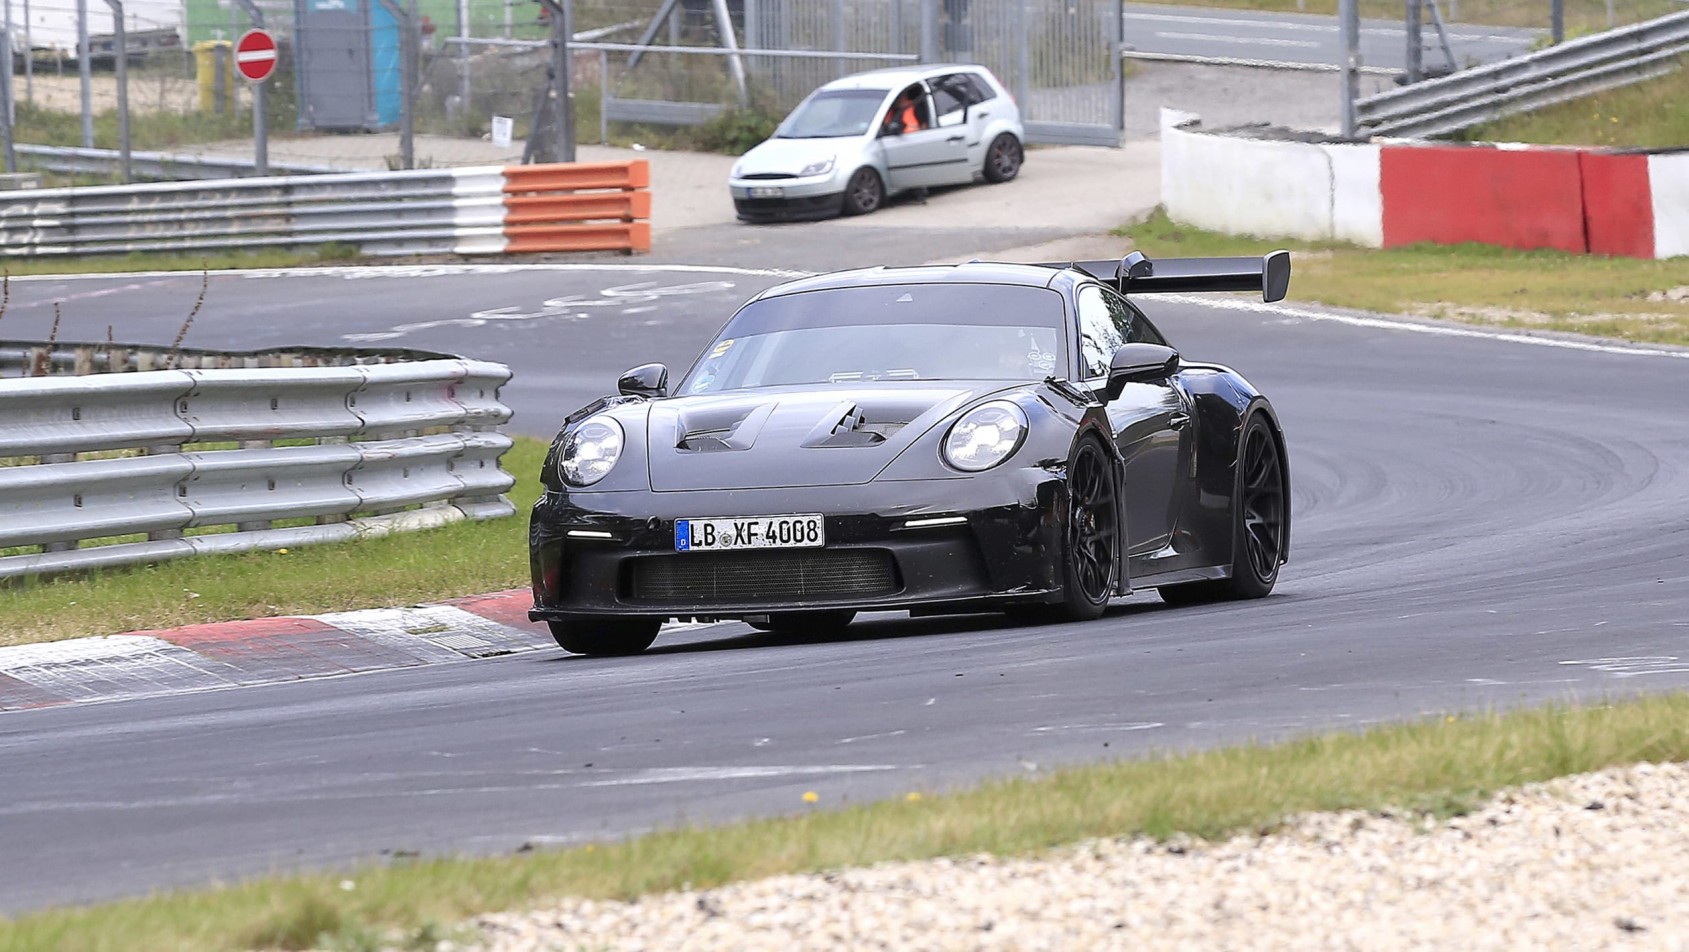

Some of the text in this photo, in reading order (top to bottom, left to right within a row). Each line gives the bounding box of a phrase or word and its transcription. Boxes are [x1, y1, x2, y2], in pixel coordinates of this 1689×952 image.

[690, 519, 818, 547] LB XF 4008
